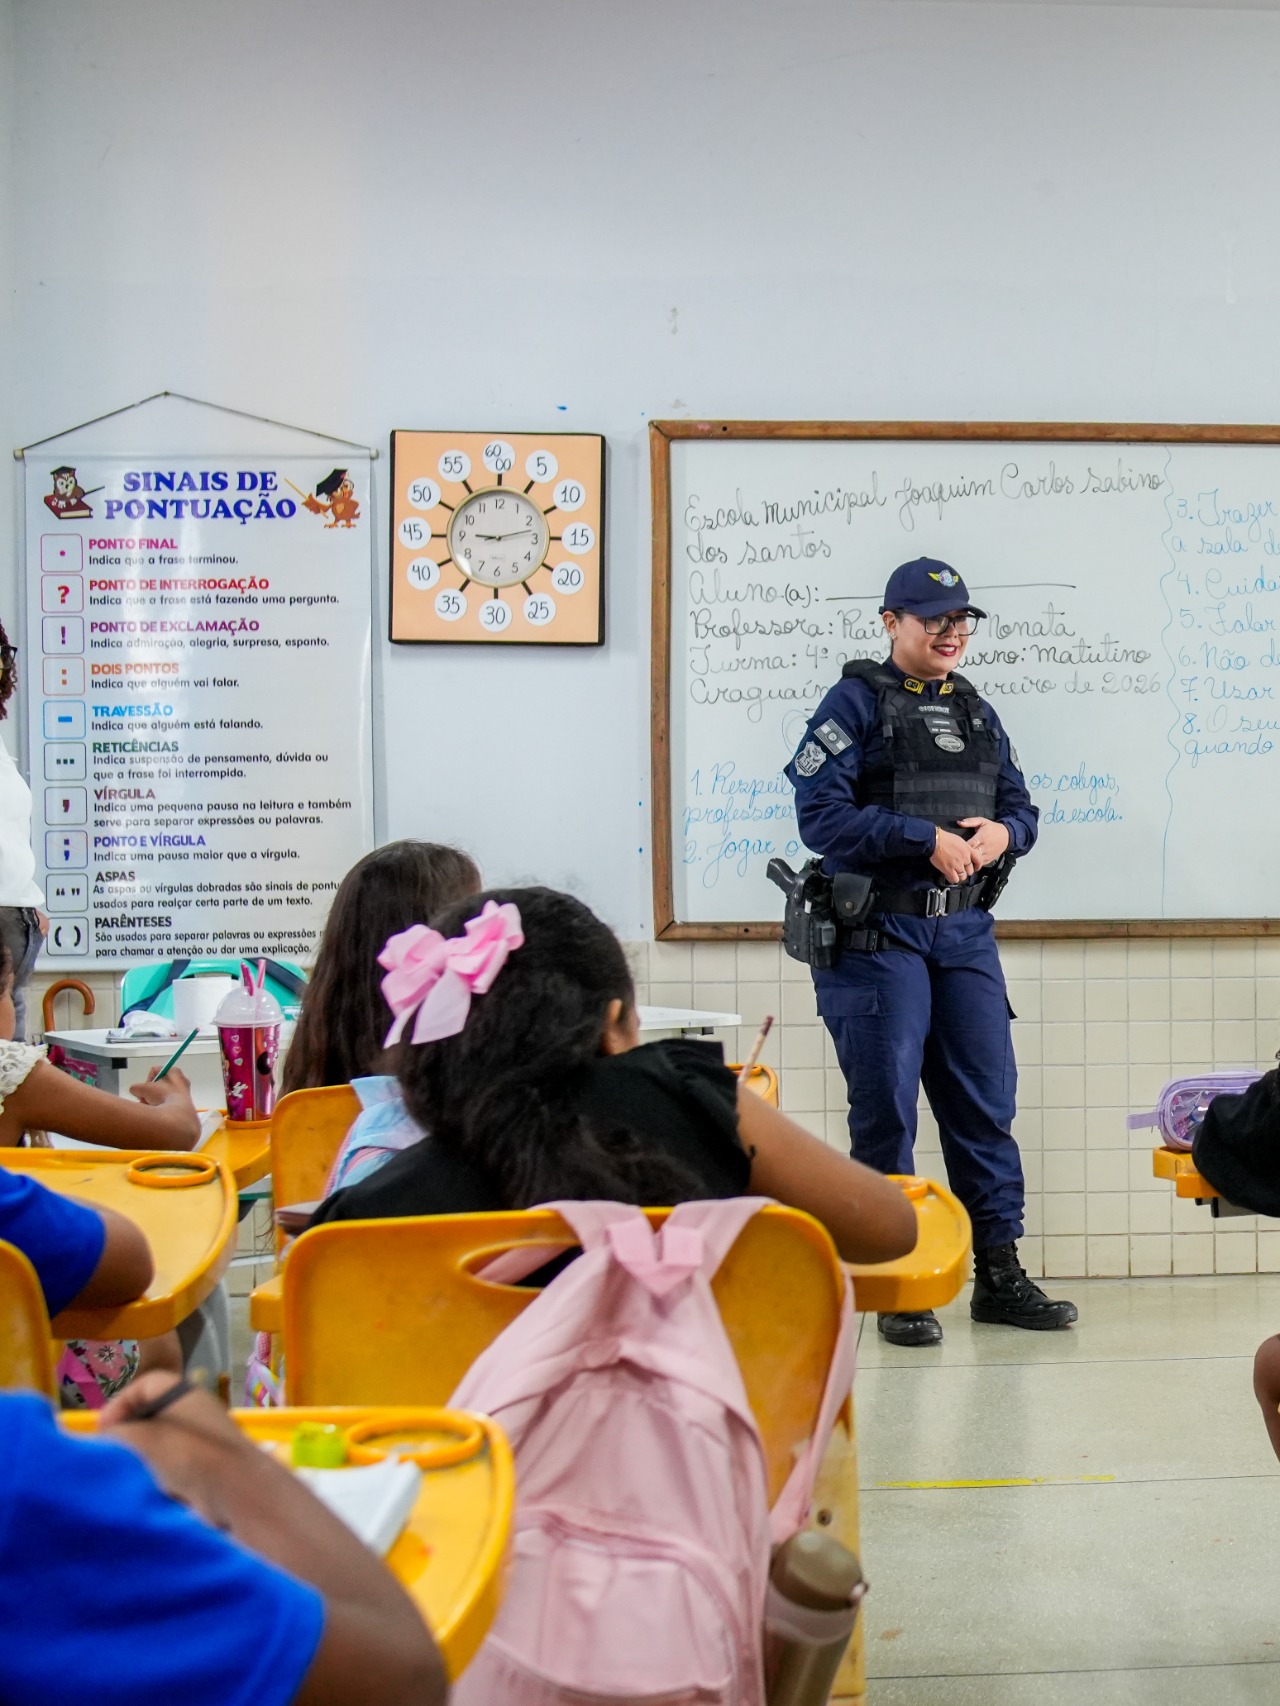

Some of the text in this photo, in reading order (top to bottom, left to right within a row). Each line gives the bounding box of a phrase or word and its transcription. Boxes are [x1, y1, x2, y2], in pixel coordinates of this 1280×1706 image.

[485, 444, 501, 457] 60
[443, 456, 463, 474] 55
[495, 458, 511, 471] 00
[537, 457, 547, 476] 5
[123, 471, 278, 493] SINAIS DE
[412, 485, 431, 503] 50
[560, 486, 580, 503] 10
[684, 487, 759, 532] Escola
[895, 476, 995, 532] Joaquim
[1000, 461, 1074, 499] Carlos
[104, 492, 297, 525] PONTUAÇÃO
[403, 524, 422, 540] 45
[570, 529, 589, 546] 15
[88, 538, 178, 550] PONTO FINAL
[412, 565, 431, 580] 40
[557, 569, 581, 586] 20
[89, 576, 269, 594] PONTO DE INTERROGAÇÃO
[437, 595, 460, 614] 35
[528, 601, 549, 619] 25
[484, 607, 505, 625] 30
[90, 617, 260, 636] PONTO DE EXCLAMAÇÃO
[690, 608, 833, 650] Professora:
[91, 636, 330, 651] Indica admiração, alegria, surpresa, espanto.
[690, 645, 796, 676] Turma:
[1179, 645, 1197, 666] 6.
[1200, 642, 1250, 670] Não
[91, 662, 179, 675] DOIS PONTOS
[1065, 671, 1160, 695] de 2026
[92, 704, 173, 717] TRAVESSÃO
[1182, 713, 1201, 734] 8.
[92, 740, 179, 753] RETICÊNCIAS
[93, 751, 328, 767] Indica suspensão de pensamento, dúvida ou
[93, 767, 246, 782] que a frase foi interrompida.
[1030, 773, 1052, 790] os
[94, 787, 156, 800] VÍRGULA
[94, 798, 352, 814] Indica uma pequena pausa na leitura e também
[1044, 797, 1122, 824] da escola.
[94, 814, 323, 829] serve para separar expressões ou palavras.
[93, 832, 206, 848] PONTO E VÍRGULA
[94, 848, 300, 863] Indica uma pausa maior que a vírgula.
[95, 871, 135, 882] ASPAS
[93, 895, 313, 911] usados para realçar certa parte de um texto.
[95, 915, 172, 928] PARÊNTESES
[96, 943, 311, 960] para chamar a atenção ou dar uma explicação.
